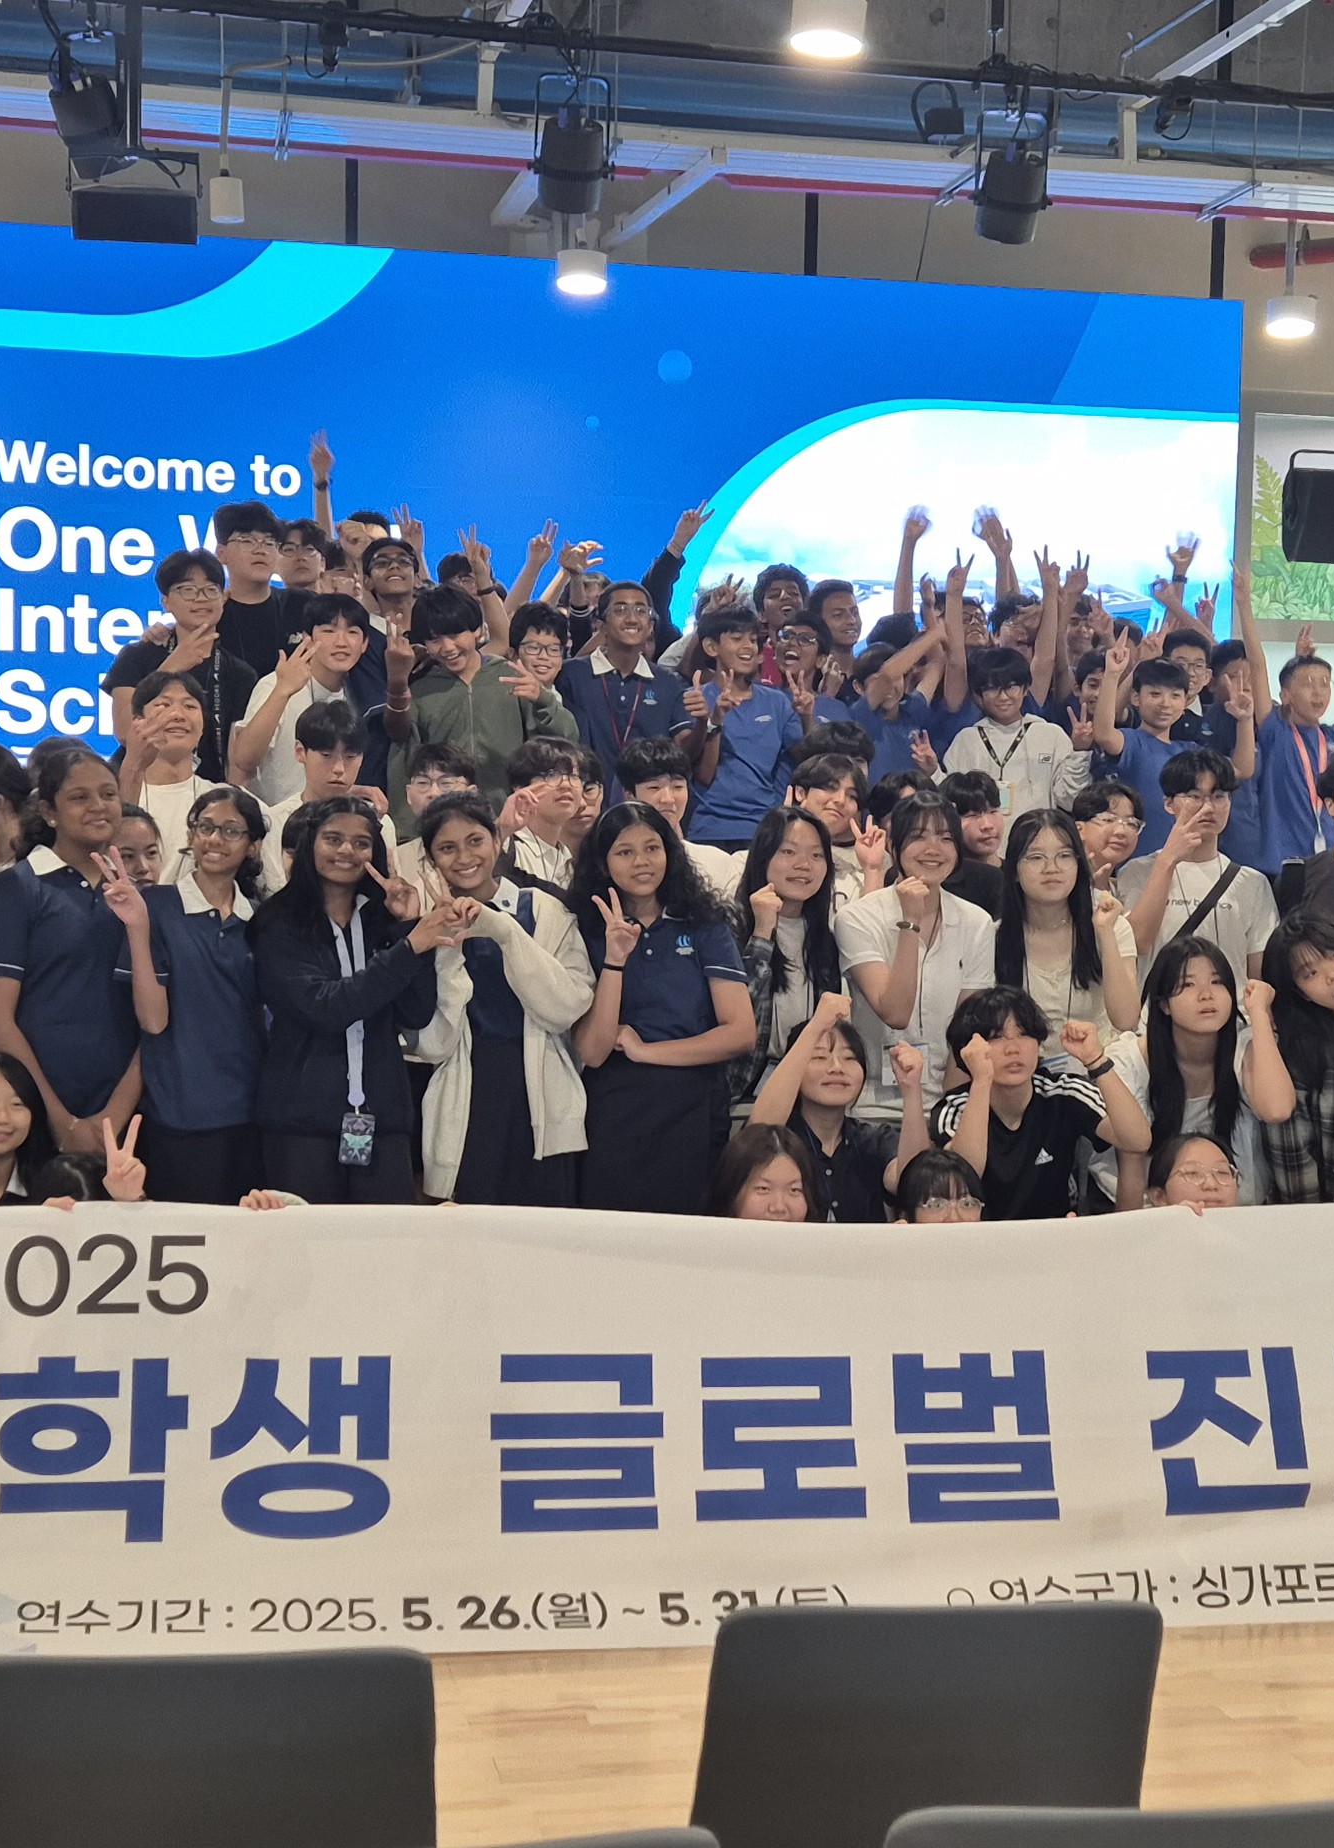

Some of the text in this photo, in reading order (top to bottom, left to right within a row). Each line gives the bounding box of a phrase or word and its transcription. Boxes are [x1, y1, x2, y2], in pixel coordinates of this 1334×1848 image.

[249, 453, 302, 497] to
[489, 1349, 1061, 1534] 글로벌
[16, 1597, 211, 1634] 연수기간
[249, 1597, 388, 1633] 2025.
